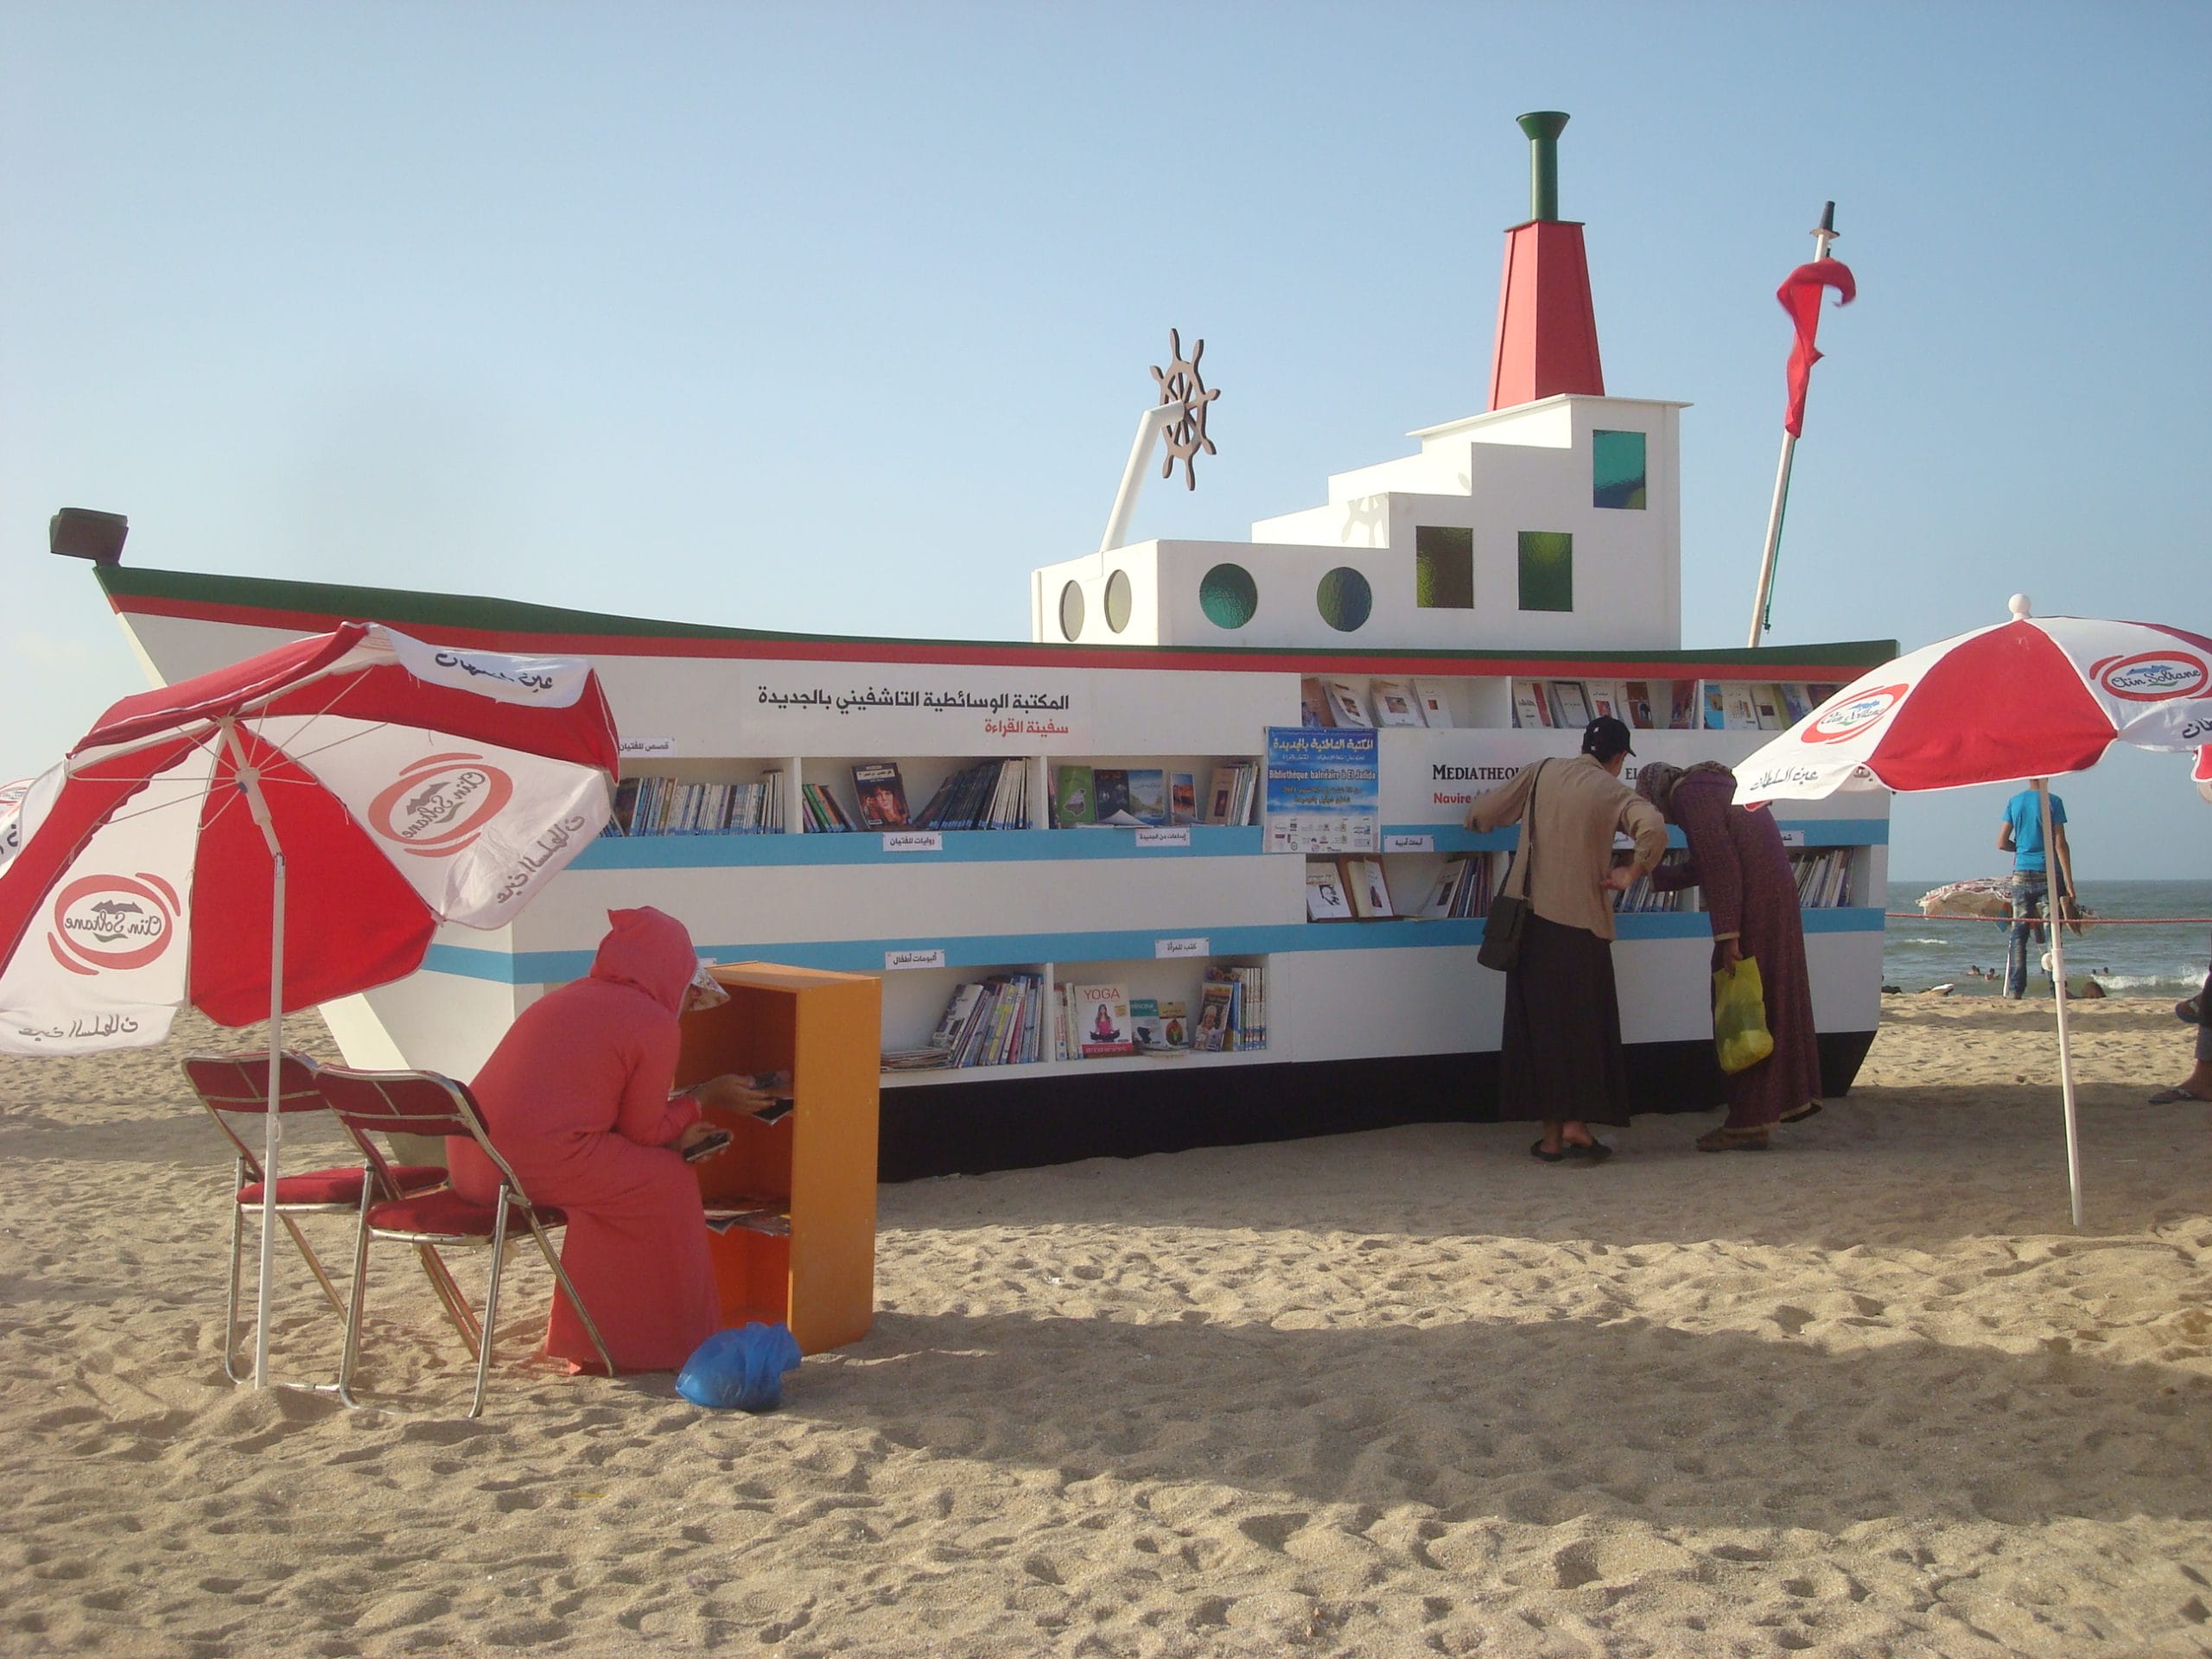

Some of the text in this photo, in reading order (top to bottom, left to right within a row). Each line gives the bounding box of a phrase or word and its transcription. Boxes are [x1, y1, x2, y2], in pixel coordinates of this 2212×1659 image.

[2144, 669, 2202, 683] Soltane
[758, 685, 1070, 715] المكتبة الوسائطية التاشفيني بالجديدة
[984, 717, 1070, 739] سفينة القراءة
[645, 741, 669, 752] قصص
[1433, 765, 1519, 780] MEDIATHEQ
[1433, 791, 1471, 804] Navire
[890, 836, 935, 846] روايات للفتيان
[1183, 943, 1197, 951] كتب
[893, 952, 912, 965] أطفال
[1084, 988, 1121, 1001] YOGA
